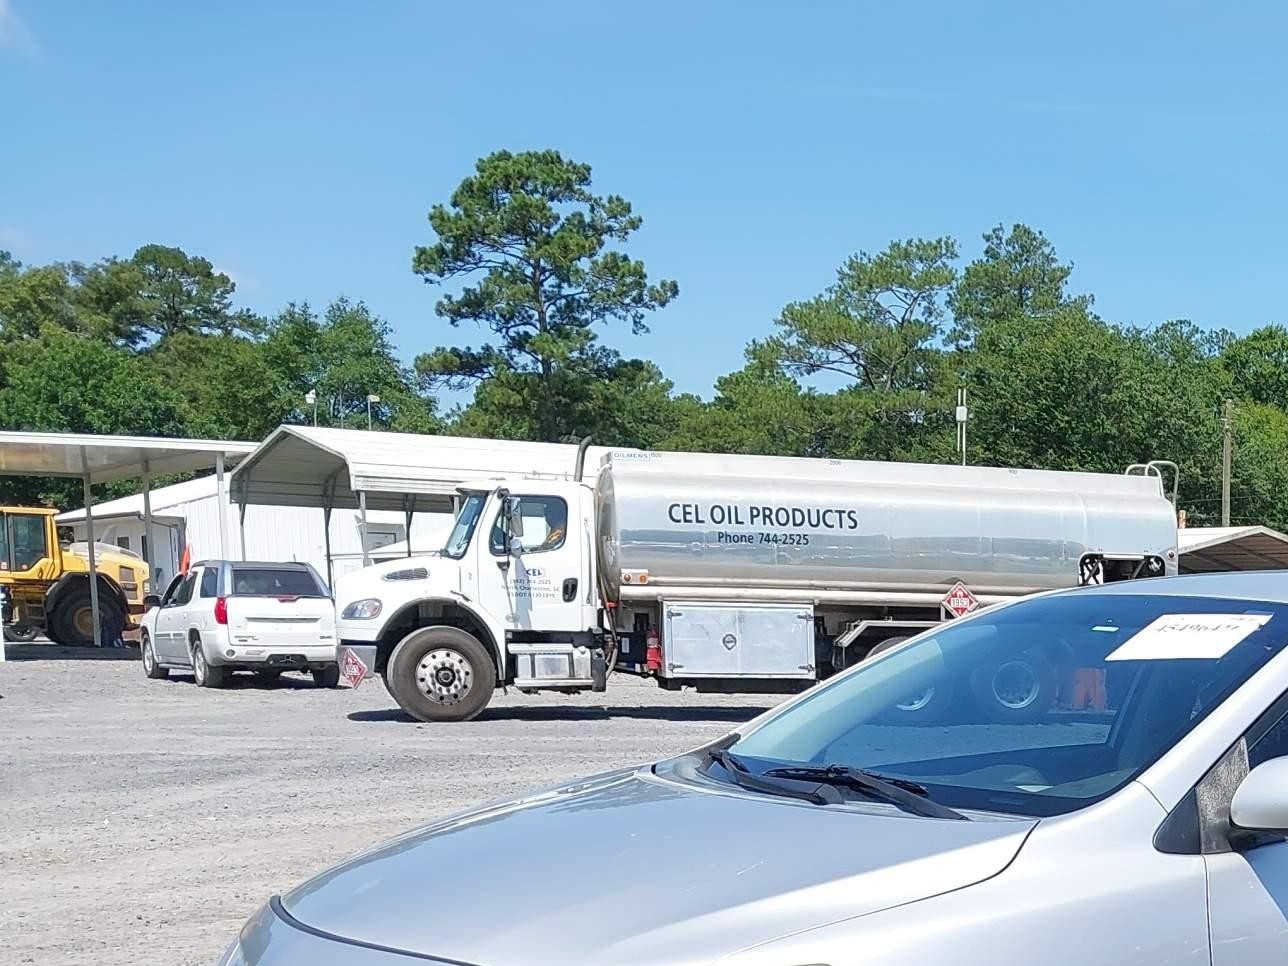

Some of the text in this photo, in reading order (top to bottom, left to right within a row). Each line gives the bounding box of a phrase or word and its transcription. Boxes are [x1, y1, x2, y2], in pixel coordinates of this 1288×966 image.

[668, 502, 858, 530] CEL OIL PRODUCTS
[718, 530, 809, 546] Phone 744-2525
